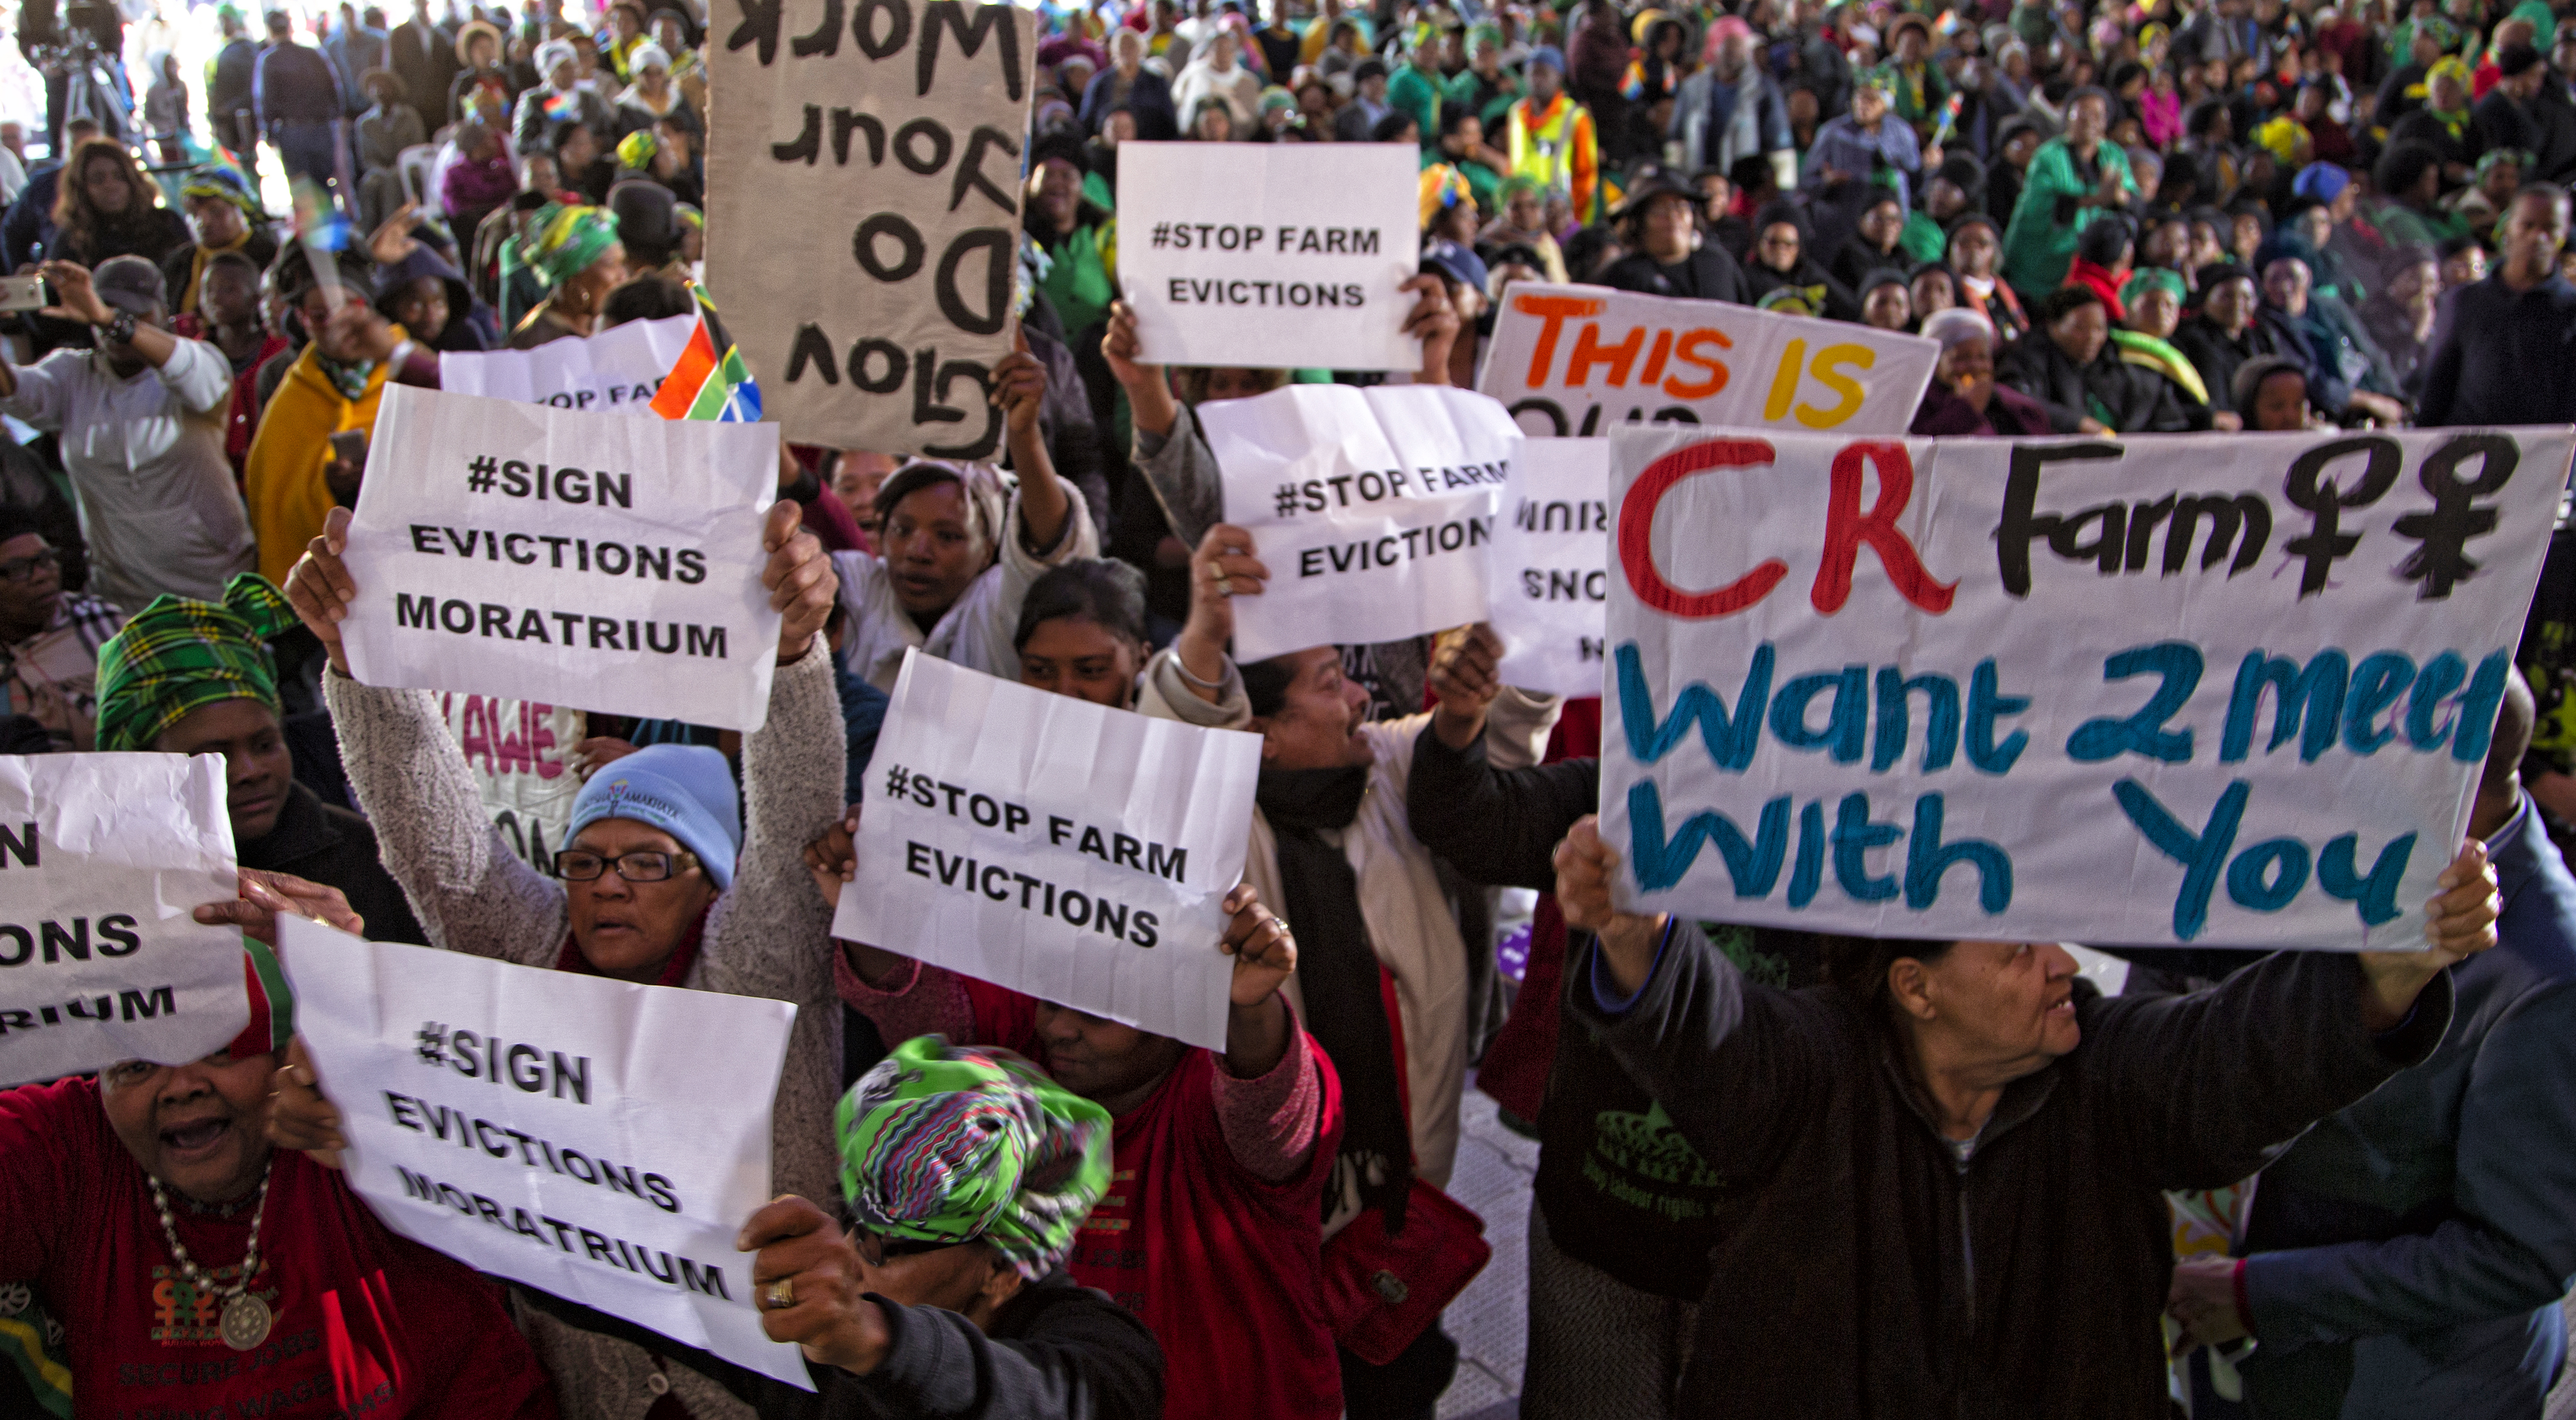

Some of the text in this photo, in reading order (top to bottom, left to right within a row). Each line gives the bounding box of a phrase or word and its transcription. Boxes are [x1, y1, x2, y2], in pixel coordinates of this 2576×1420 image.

[853, 212, 1012, 335] Do
[1152, 221, 1380, 255] #STOP FARM
[1169, 278, 1365, 307] EVICTIONS
[786, 323, 1003, 461] Gov
[1513, 293, 1877, 430] THIS IS
[468, 455, 632, 509] #SIGN
[1275, 460, 1510, 517] #STOP FARM
[1989, 442, 2273, 600] Farm
[410, 524, 707, 584] EVICTIONS
[397, 593, 728, 659] MORATRIUM
[1614, 639, 2033, 774] Want
[2066, 639, 2205, 765] 2
[886, 763, 1188, 884] #STOP FARM
[2111, 775, 2419, 942] You
[906, 840, 1159, 948] EVICTIONS
[415, 1020, 594, 1106] #SIGN
[380, 1089, 685, 1215] EVICTIONS
[393, 1163, 736, 1302] MORATRIUM
[117, 1328, 321, 1387] SECURE JOBS
